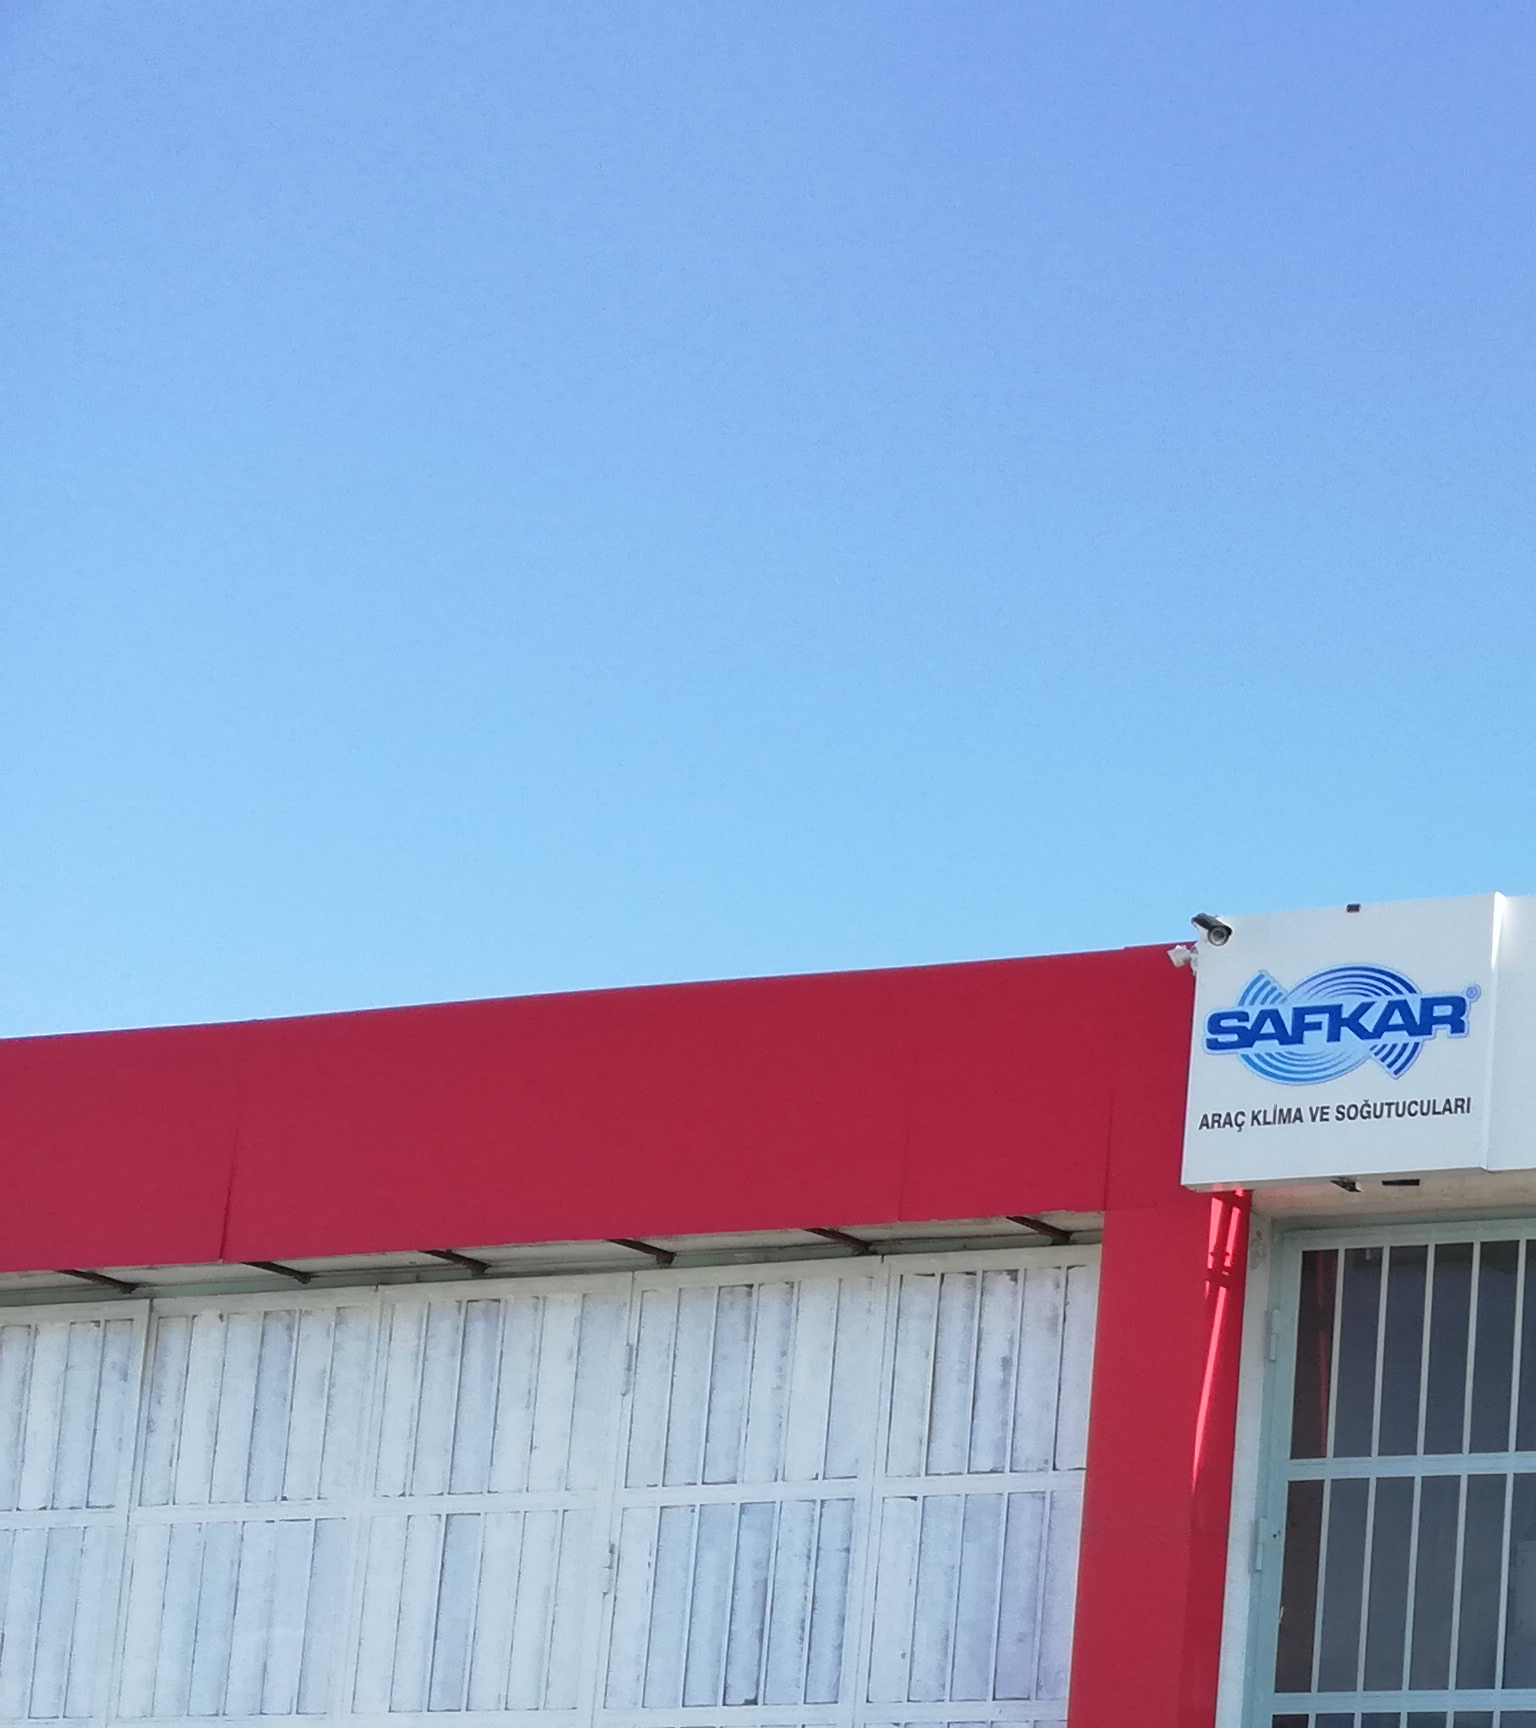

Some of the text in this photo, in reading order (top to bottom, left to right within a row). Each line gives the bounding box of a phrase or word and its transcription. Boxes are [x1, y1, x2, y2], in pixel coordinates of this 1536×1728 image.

[1206, 996, 1467, 1050] SAFKAR
[1199, 1097, 1471, 1132] ARAÇ KLİMA VE SOĞUTUCULARI
